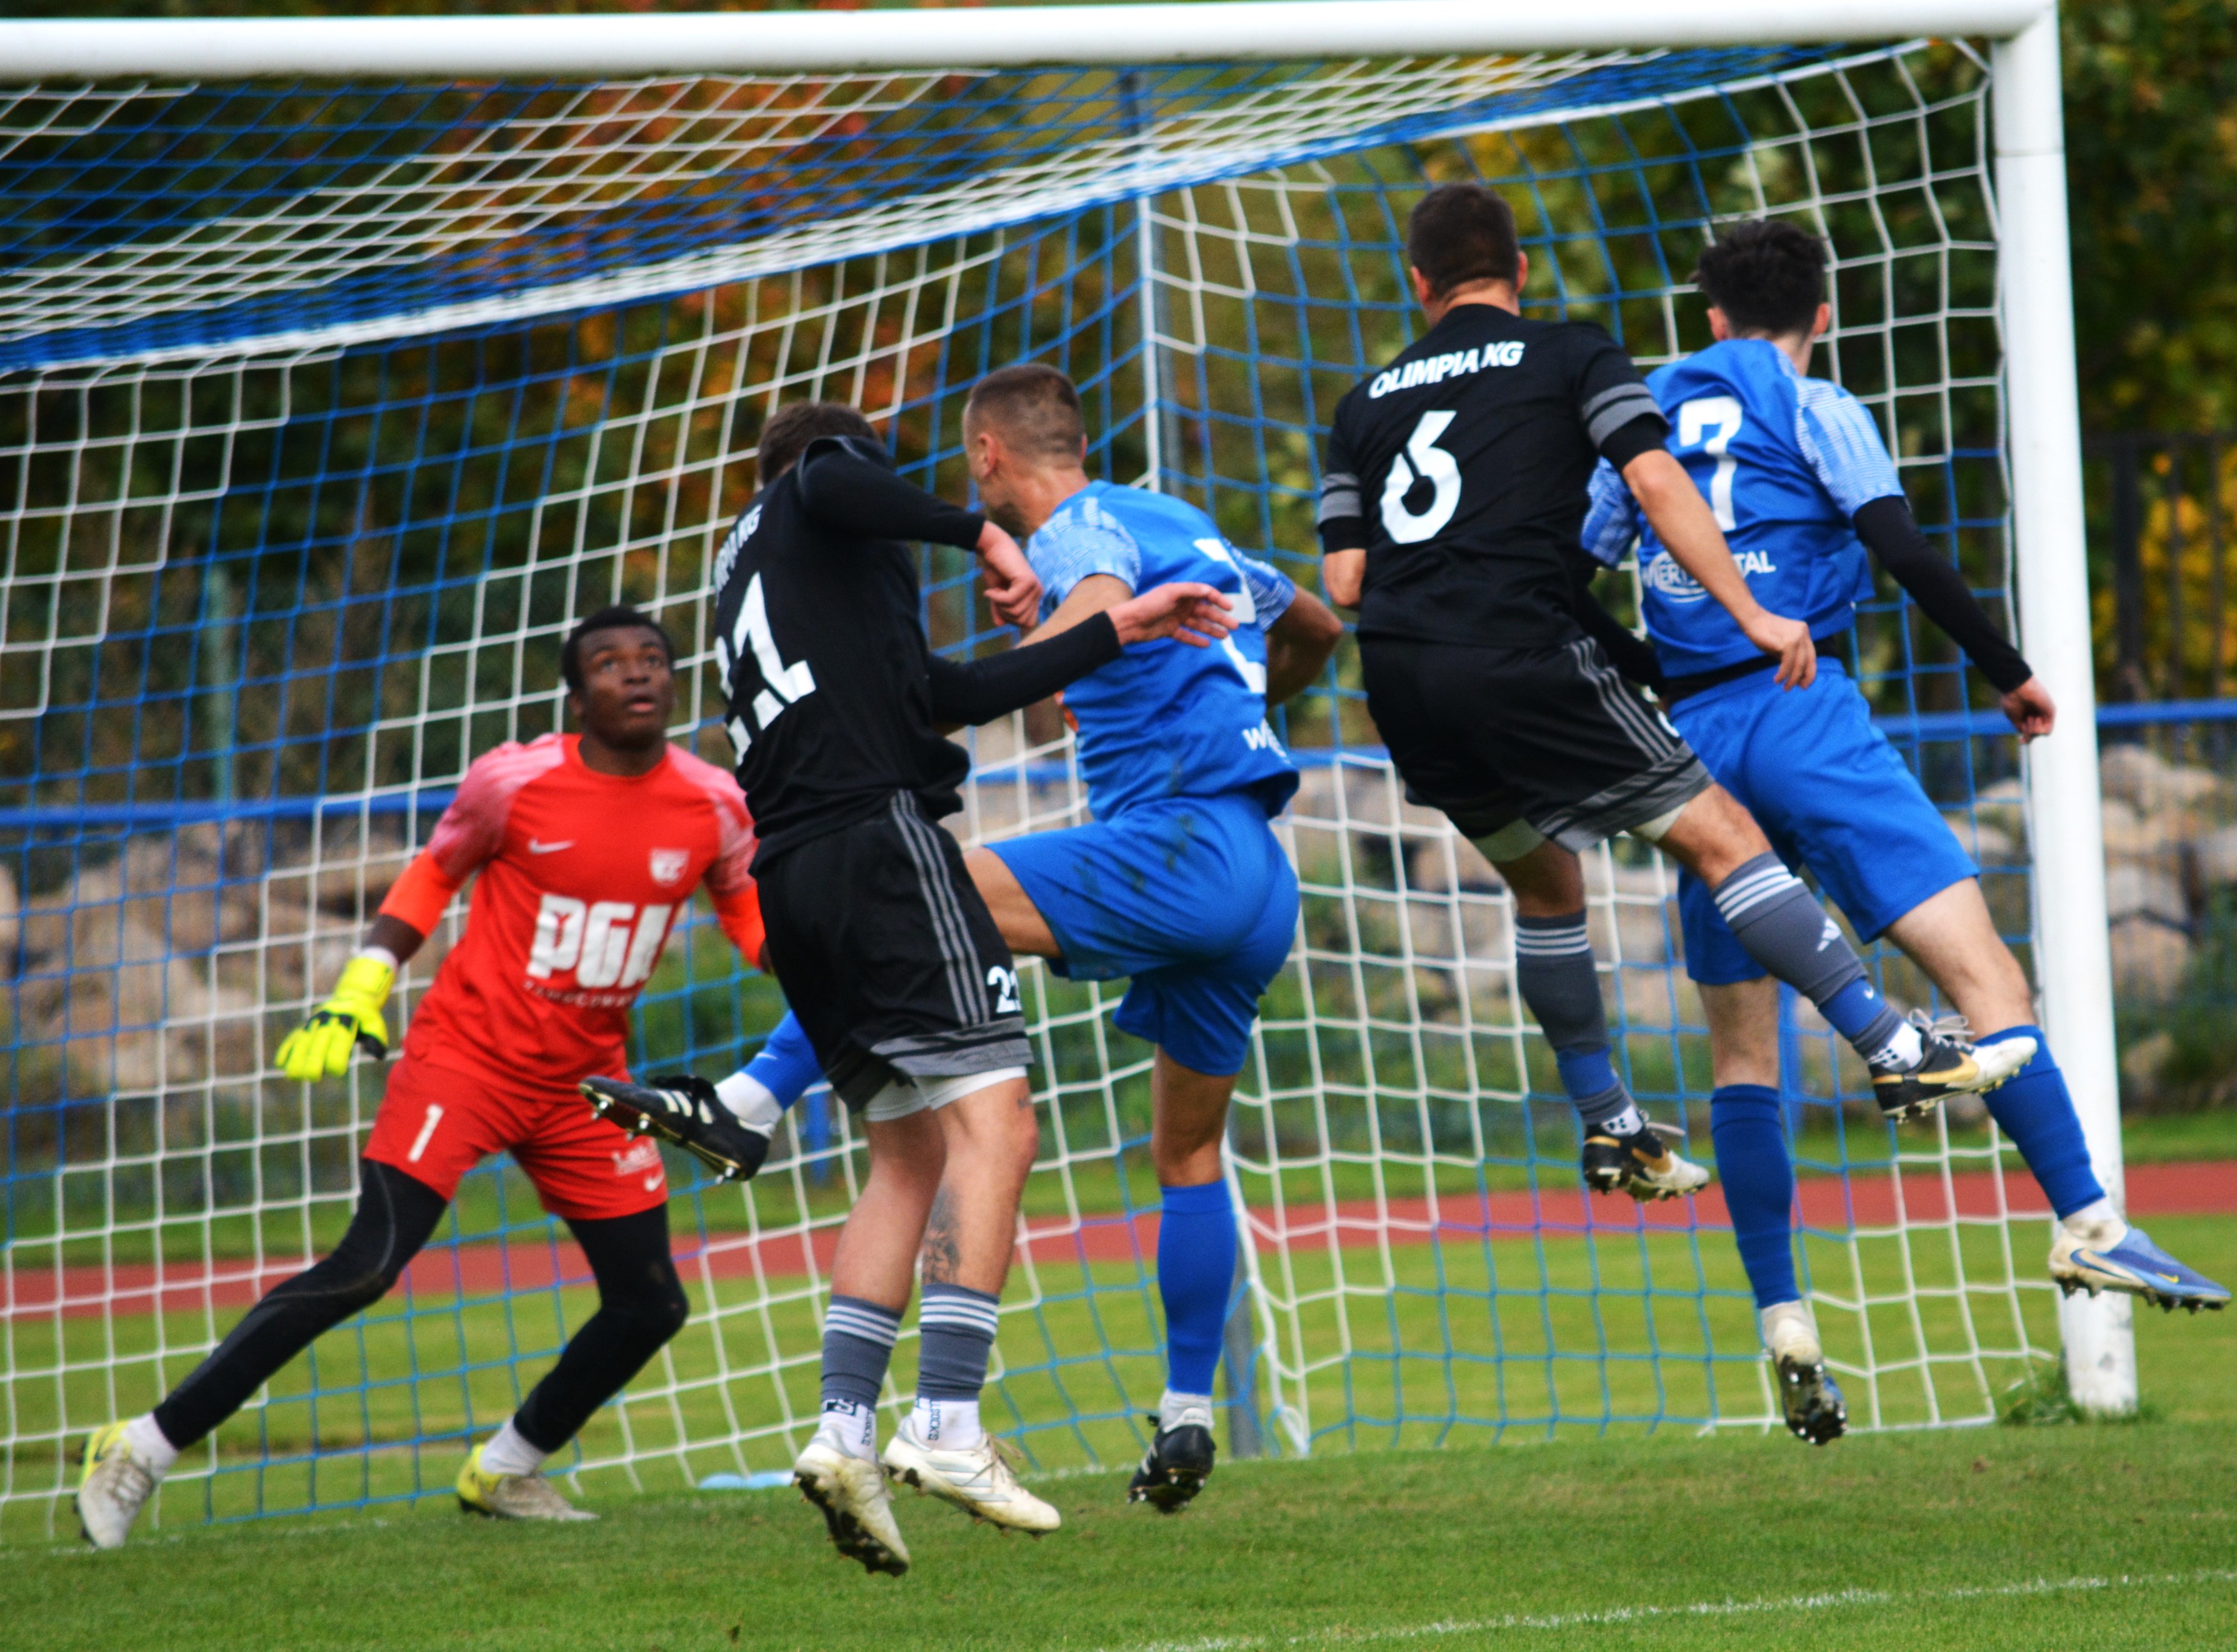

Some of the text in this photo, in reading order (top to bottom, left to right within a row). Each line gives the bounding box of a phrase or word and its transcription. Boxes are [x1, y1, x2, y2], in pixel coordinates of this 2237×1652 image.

[1368, 340, 1525, 399] OLIMPIA KG
[1380, 409, 1462, 544] 6
[1678, 395, 1743, 532] 7
[408, 1104, 445, 1163] 1
